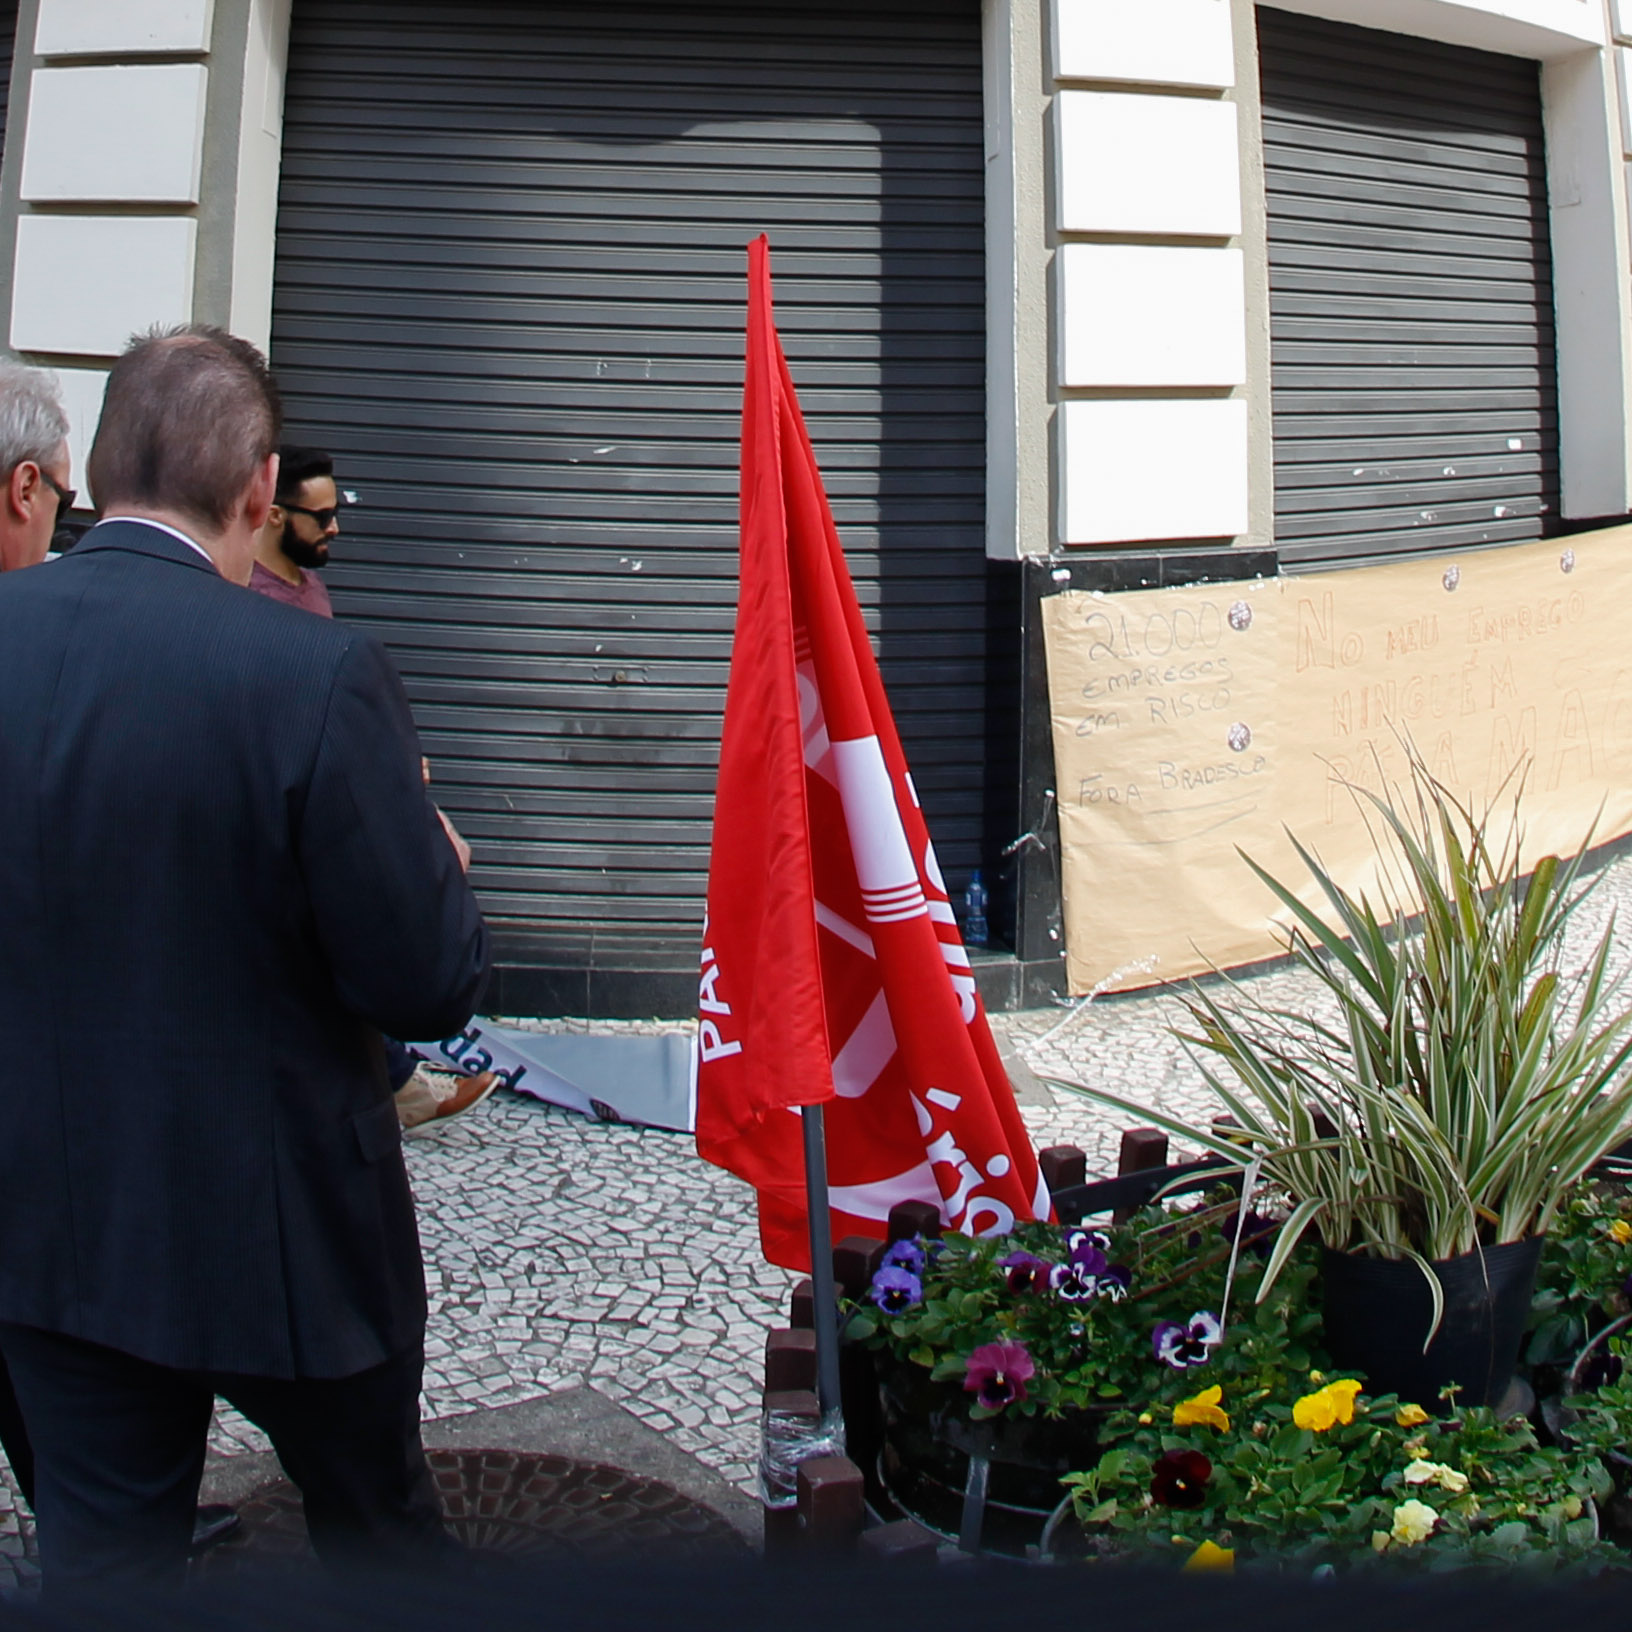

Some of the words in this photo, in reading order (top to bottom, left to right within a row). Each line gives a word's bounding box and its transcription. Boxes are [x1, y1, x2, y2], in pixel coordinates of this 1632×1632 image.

[1085, 601, 1222, 661] 21.000
[1385, 613, 1440, 661] MEU
[1082, 657, 1234, 699] EMPREGOS
[1075, 711, 1121, 737] EM
[1145, 687, 1231, 725] RISCO
